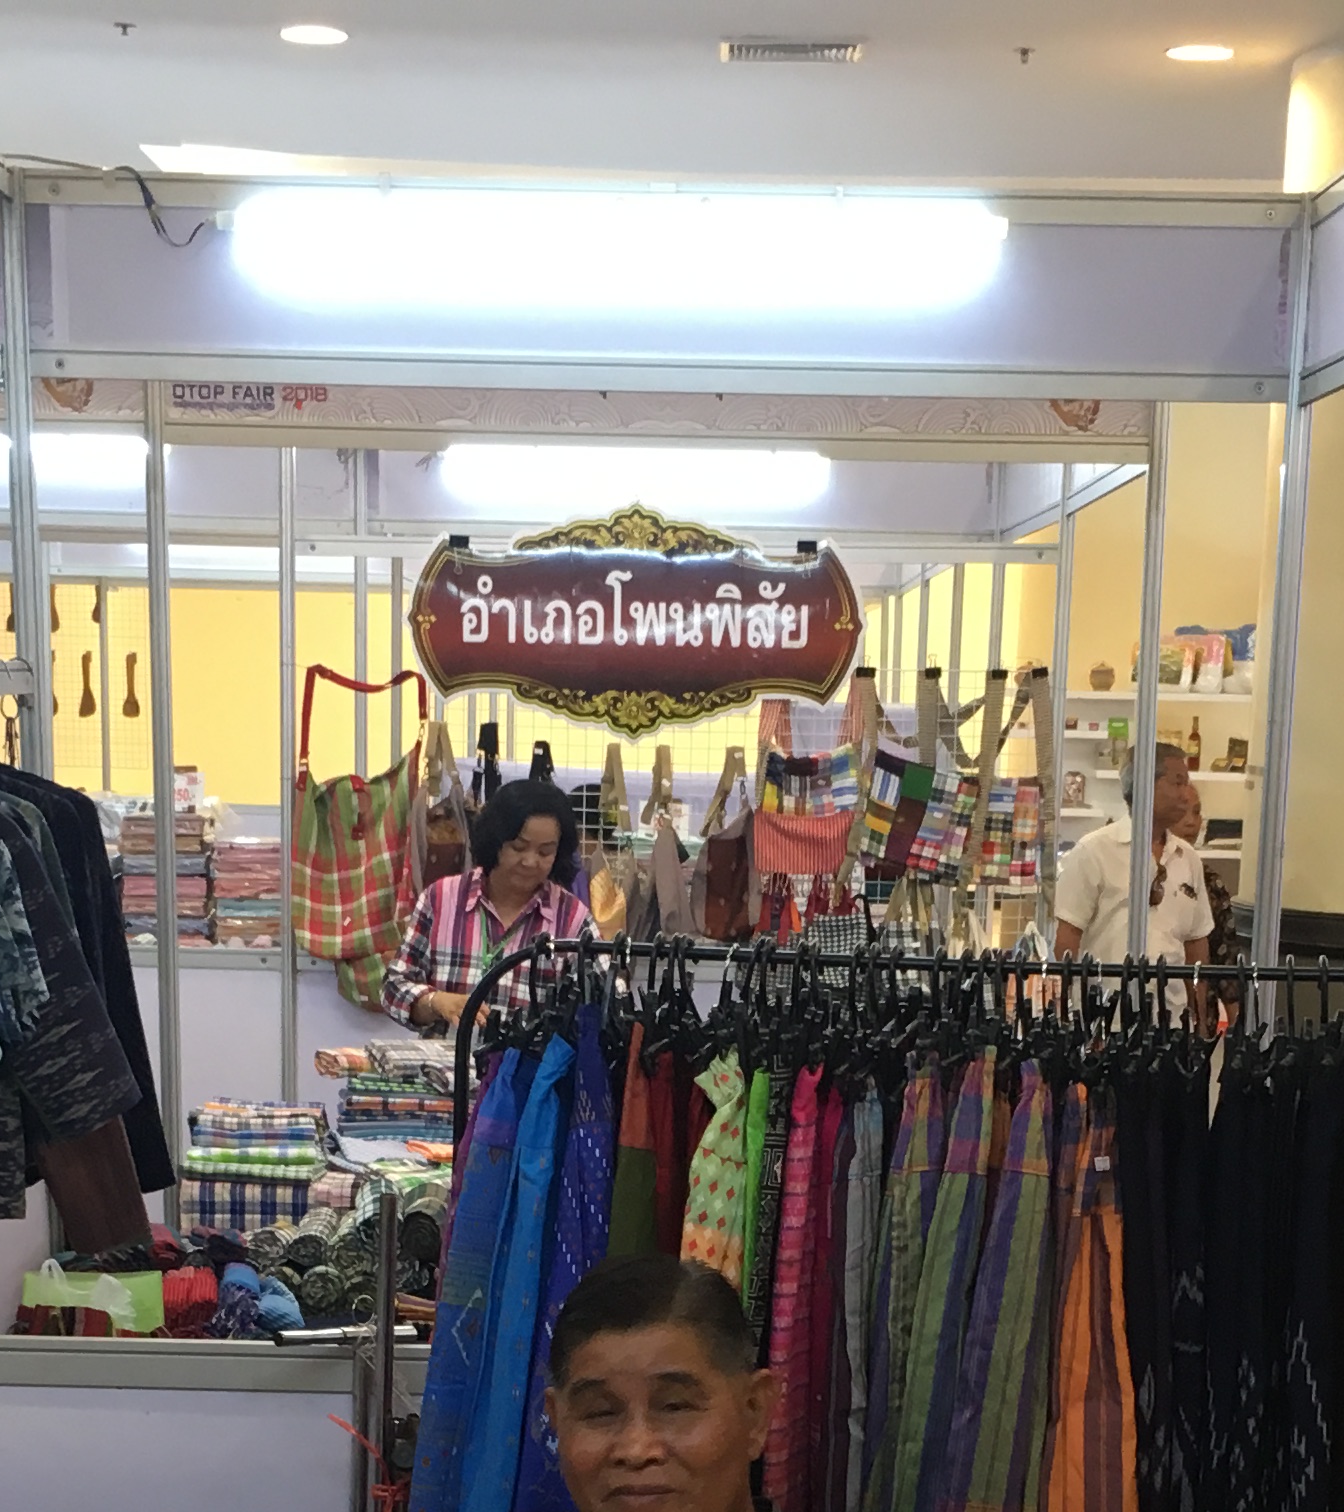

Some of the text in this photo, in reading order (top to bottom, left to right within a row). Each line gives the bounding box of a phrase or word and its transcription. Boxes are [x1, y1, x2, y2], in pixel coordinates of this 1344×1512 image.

[172, 383, 328, 402] OTOP FAIR 2018
[459, 570, 809, 649] อำเภอโพนพิสัย
